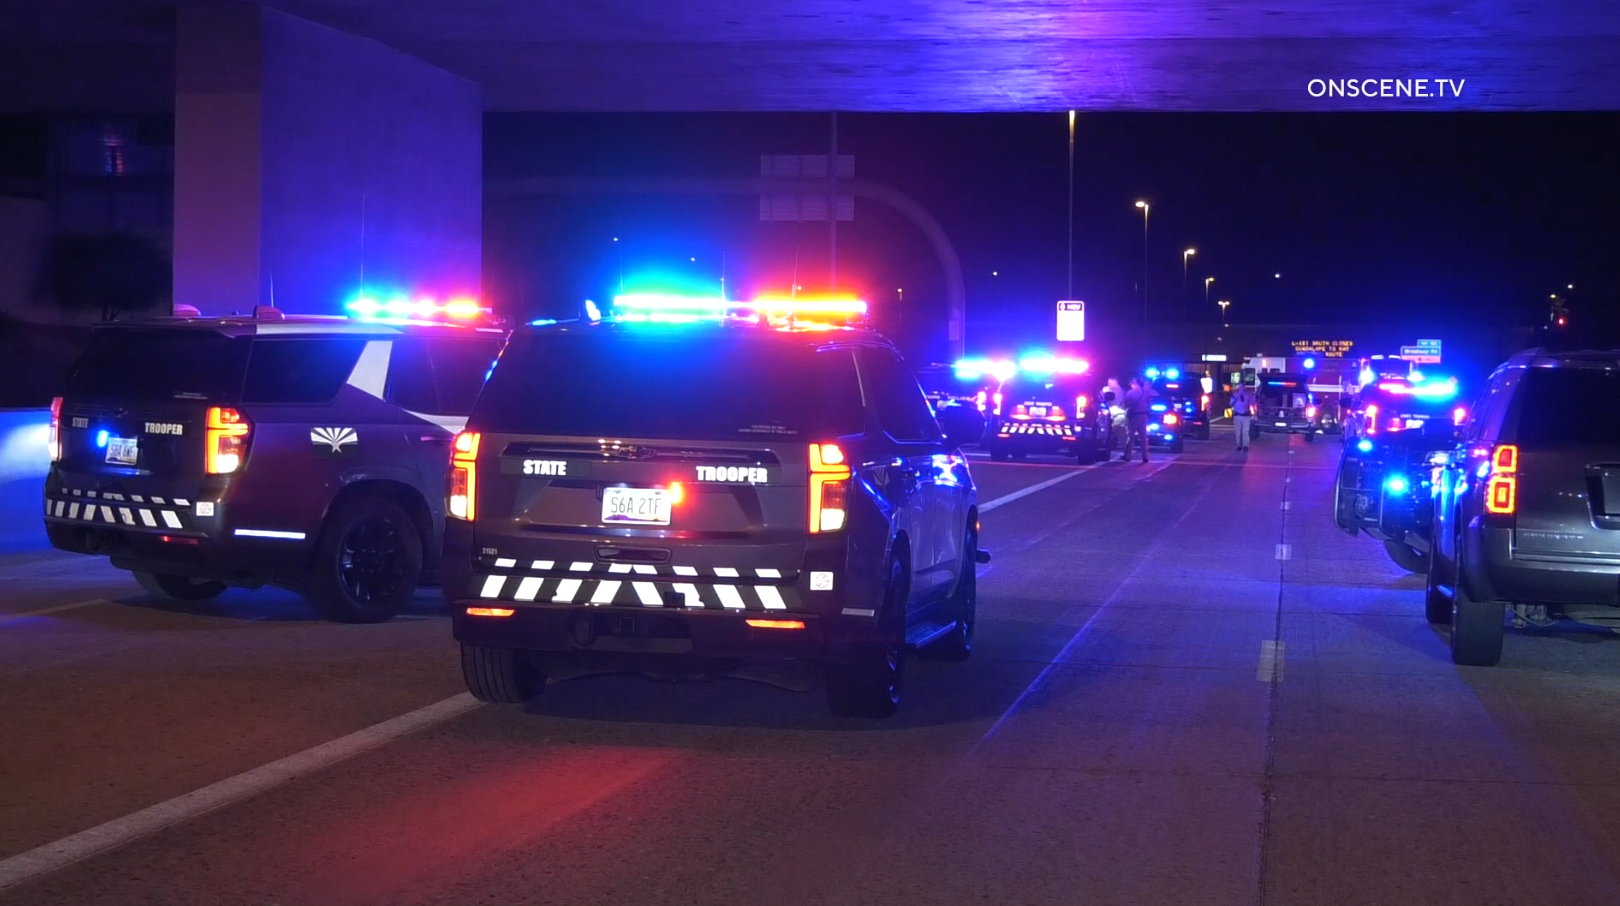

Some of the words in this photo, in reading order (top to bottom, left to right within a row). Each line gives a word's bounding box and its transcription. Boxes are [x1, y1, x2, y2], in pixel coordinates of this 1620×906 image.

[72, 417, 89, 428] STATE
[144, 422, 183, 435] TROOPER
[523, 459, 567, 476] STATE
[695, 466, 768, 483] TROOPER
[611, 496, 634, 513] S6A
[638, 497, 662, 515] 2TF
